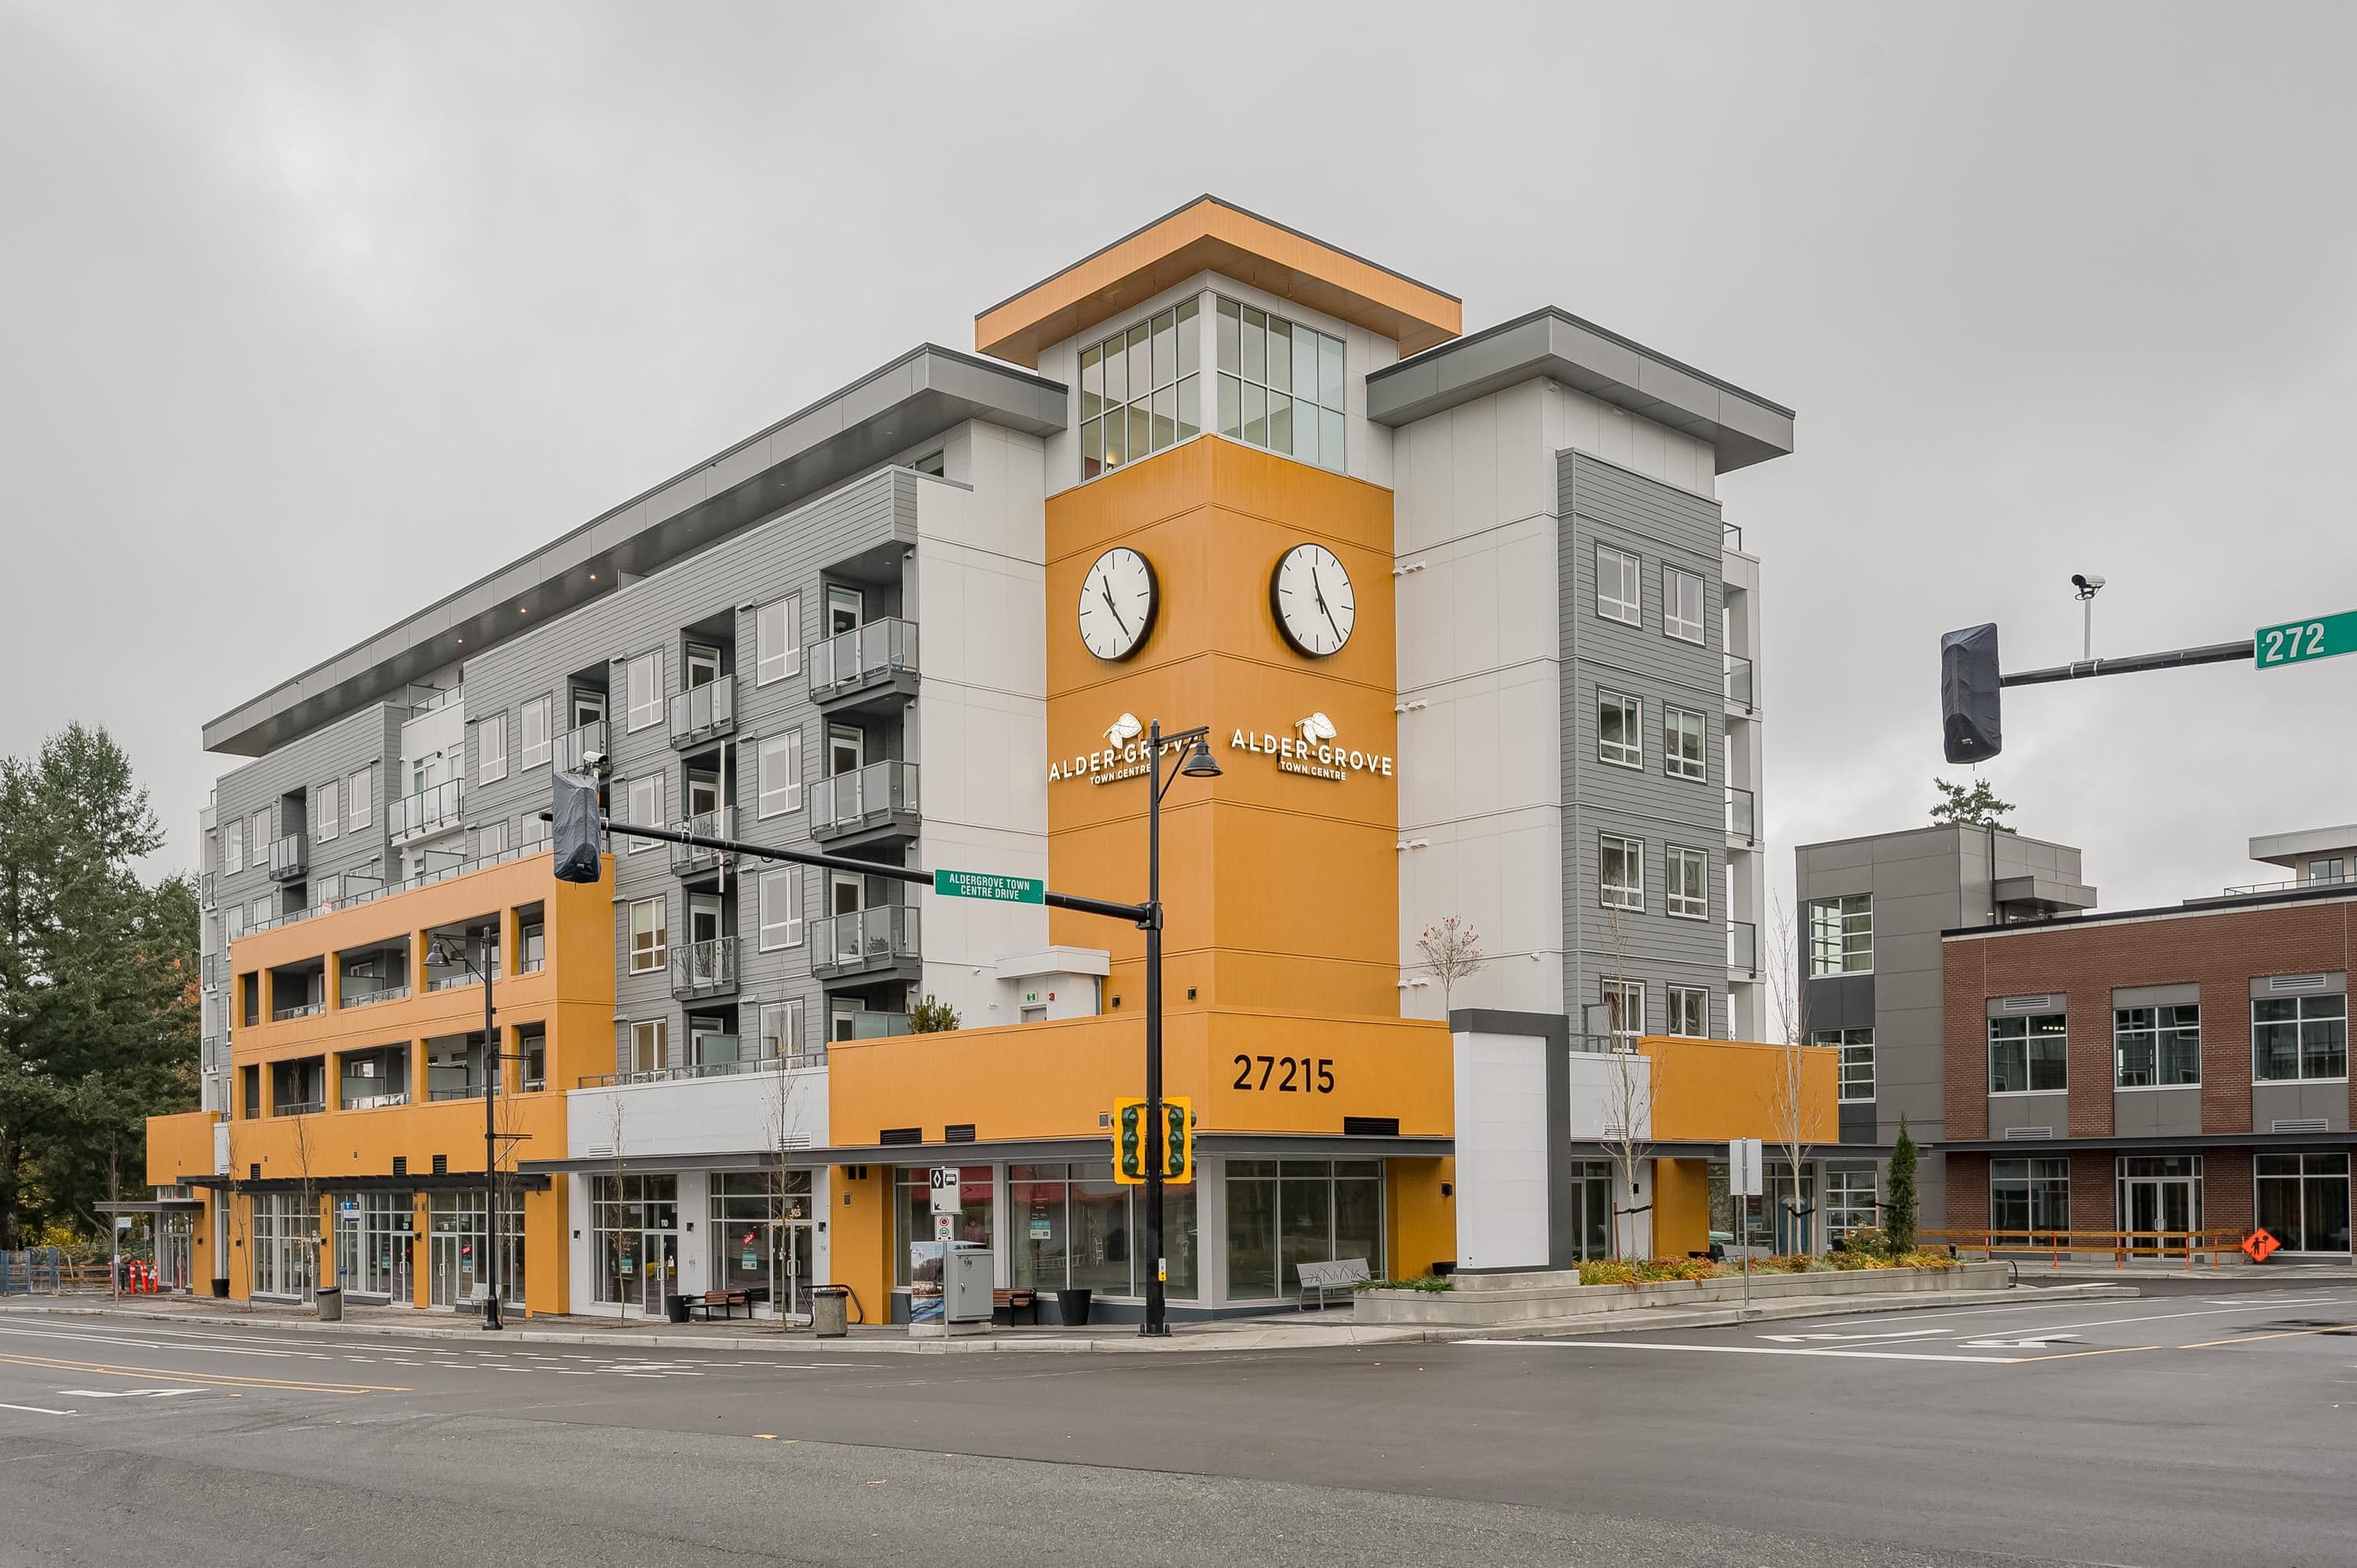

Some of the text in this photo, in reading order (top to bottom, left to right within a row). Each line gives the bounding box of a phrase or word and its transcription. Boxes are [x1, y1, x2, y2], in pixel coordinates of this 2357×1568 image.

[2266, 623, 2324, 662] 272
[1090, 764, 1151, 786] TOWN CENTRE
[1281, 760, 1347, 780] TOWN CENTRE
[949, 874, 1030, 890] ALDERGROVE TOWN
[961, 885, 1019, 899] CENTRE DRIVE
[1233, 1054, 1334, 1094] 27215
